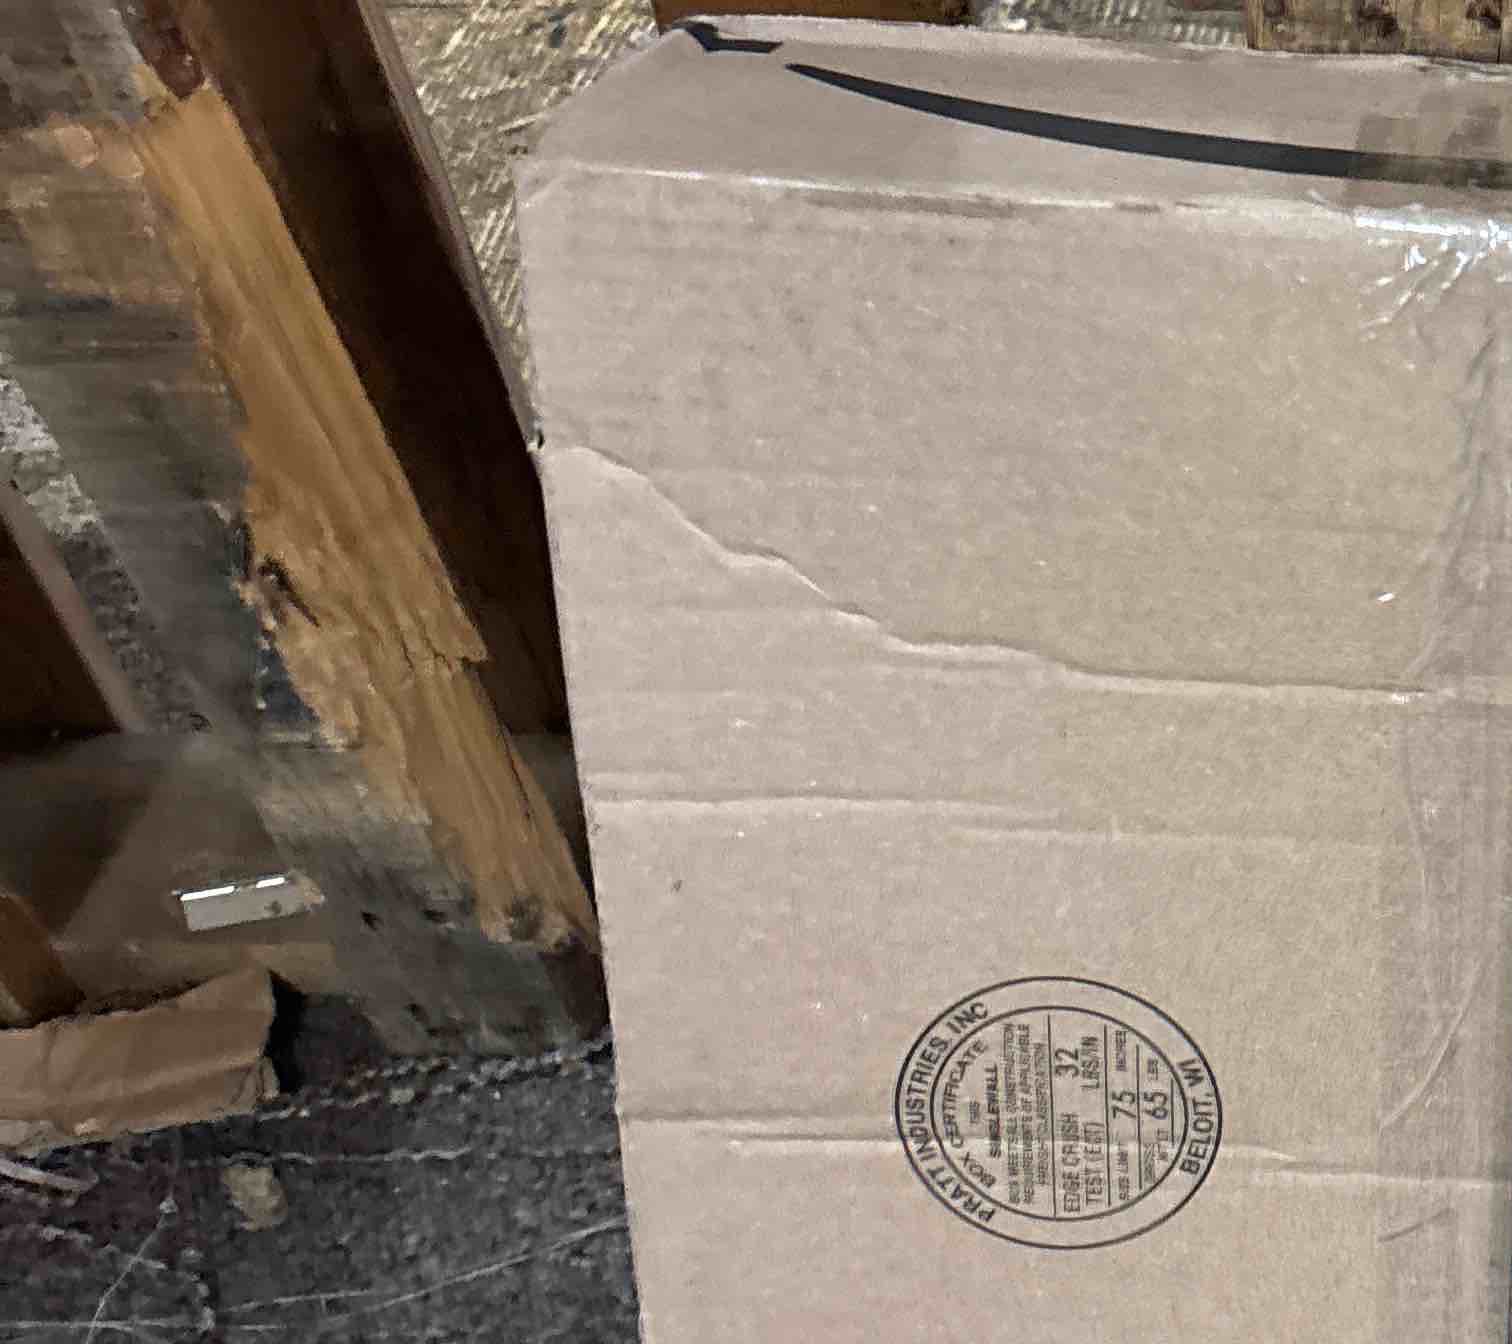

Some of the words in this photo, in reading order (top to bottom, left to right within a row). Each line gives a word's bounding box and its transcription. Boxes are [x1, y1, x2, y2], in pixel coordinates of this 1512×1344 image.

[947, 1002, 988, 1034] INC
[1055, 1048, 1078, 1078] 32
[1177, 1058, 1205, 1086] WI
[906, 1036, 949, 1161] INDUSTRIES
[943, 1038, 986, 1148] CERTIFICATE
[1112, 1089, 1136, 1119] 75
[1143, 1091, 1168, 1120] 65
[1061, 1113, 1079, 1167] CRUSH
[1084, 1121, 1104, 1162] (ECT)
[960, 1151, 995, 1188] BOX
[1085, 1168, 1102, 1205] TEST
[929, 1165, 995, 1222] PRATT
[1063, 1169, 1080, 1213] EDGE
